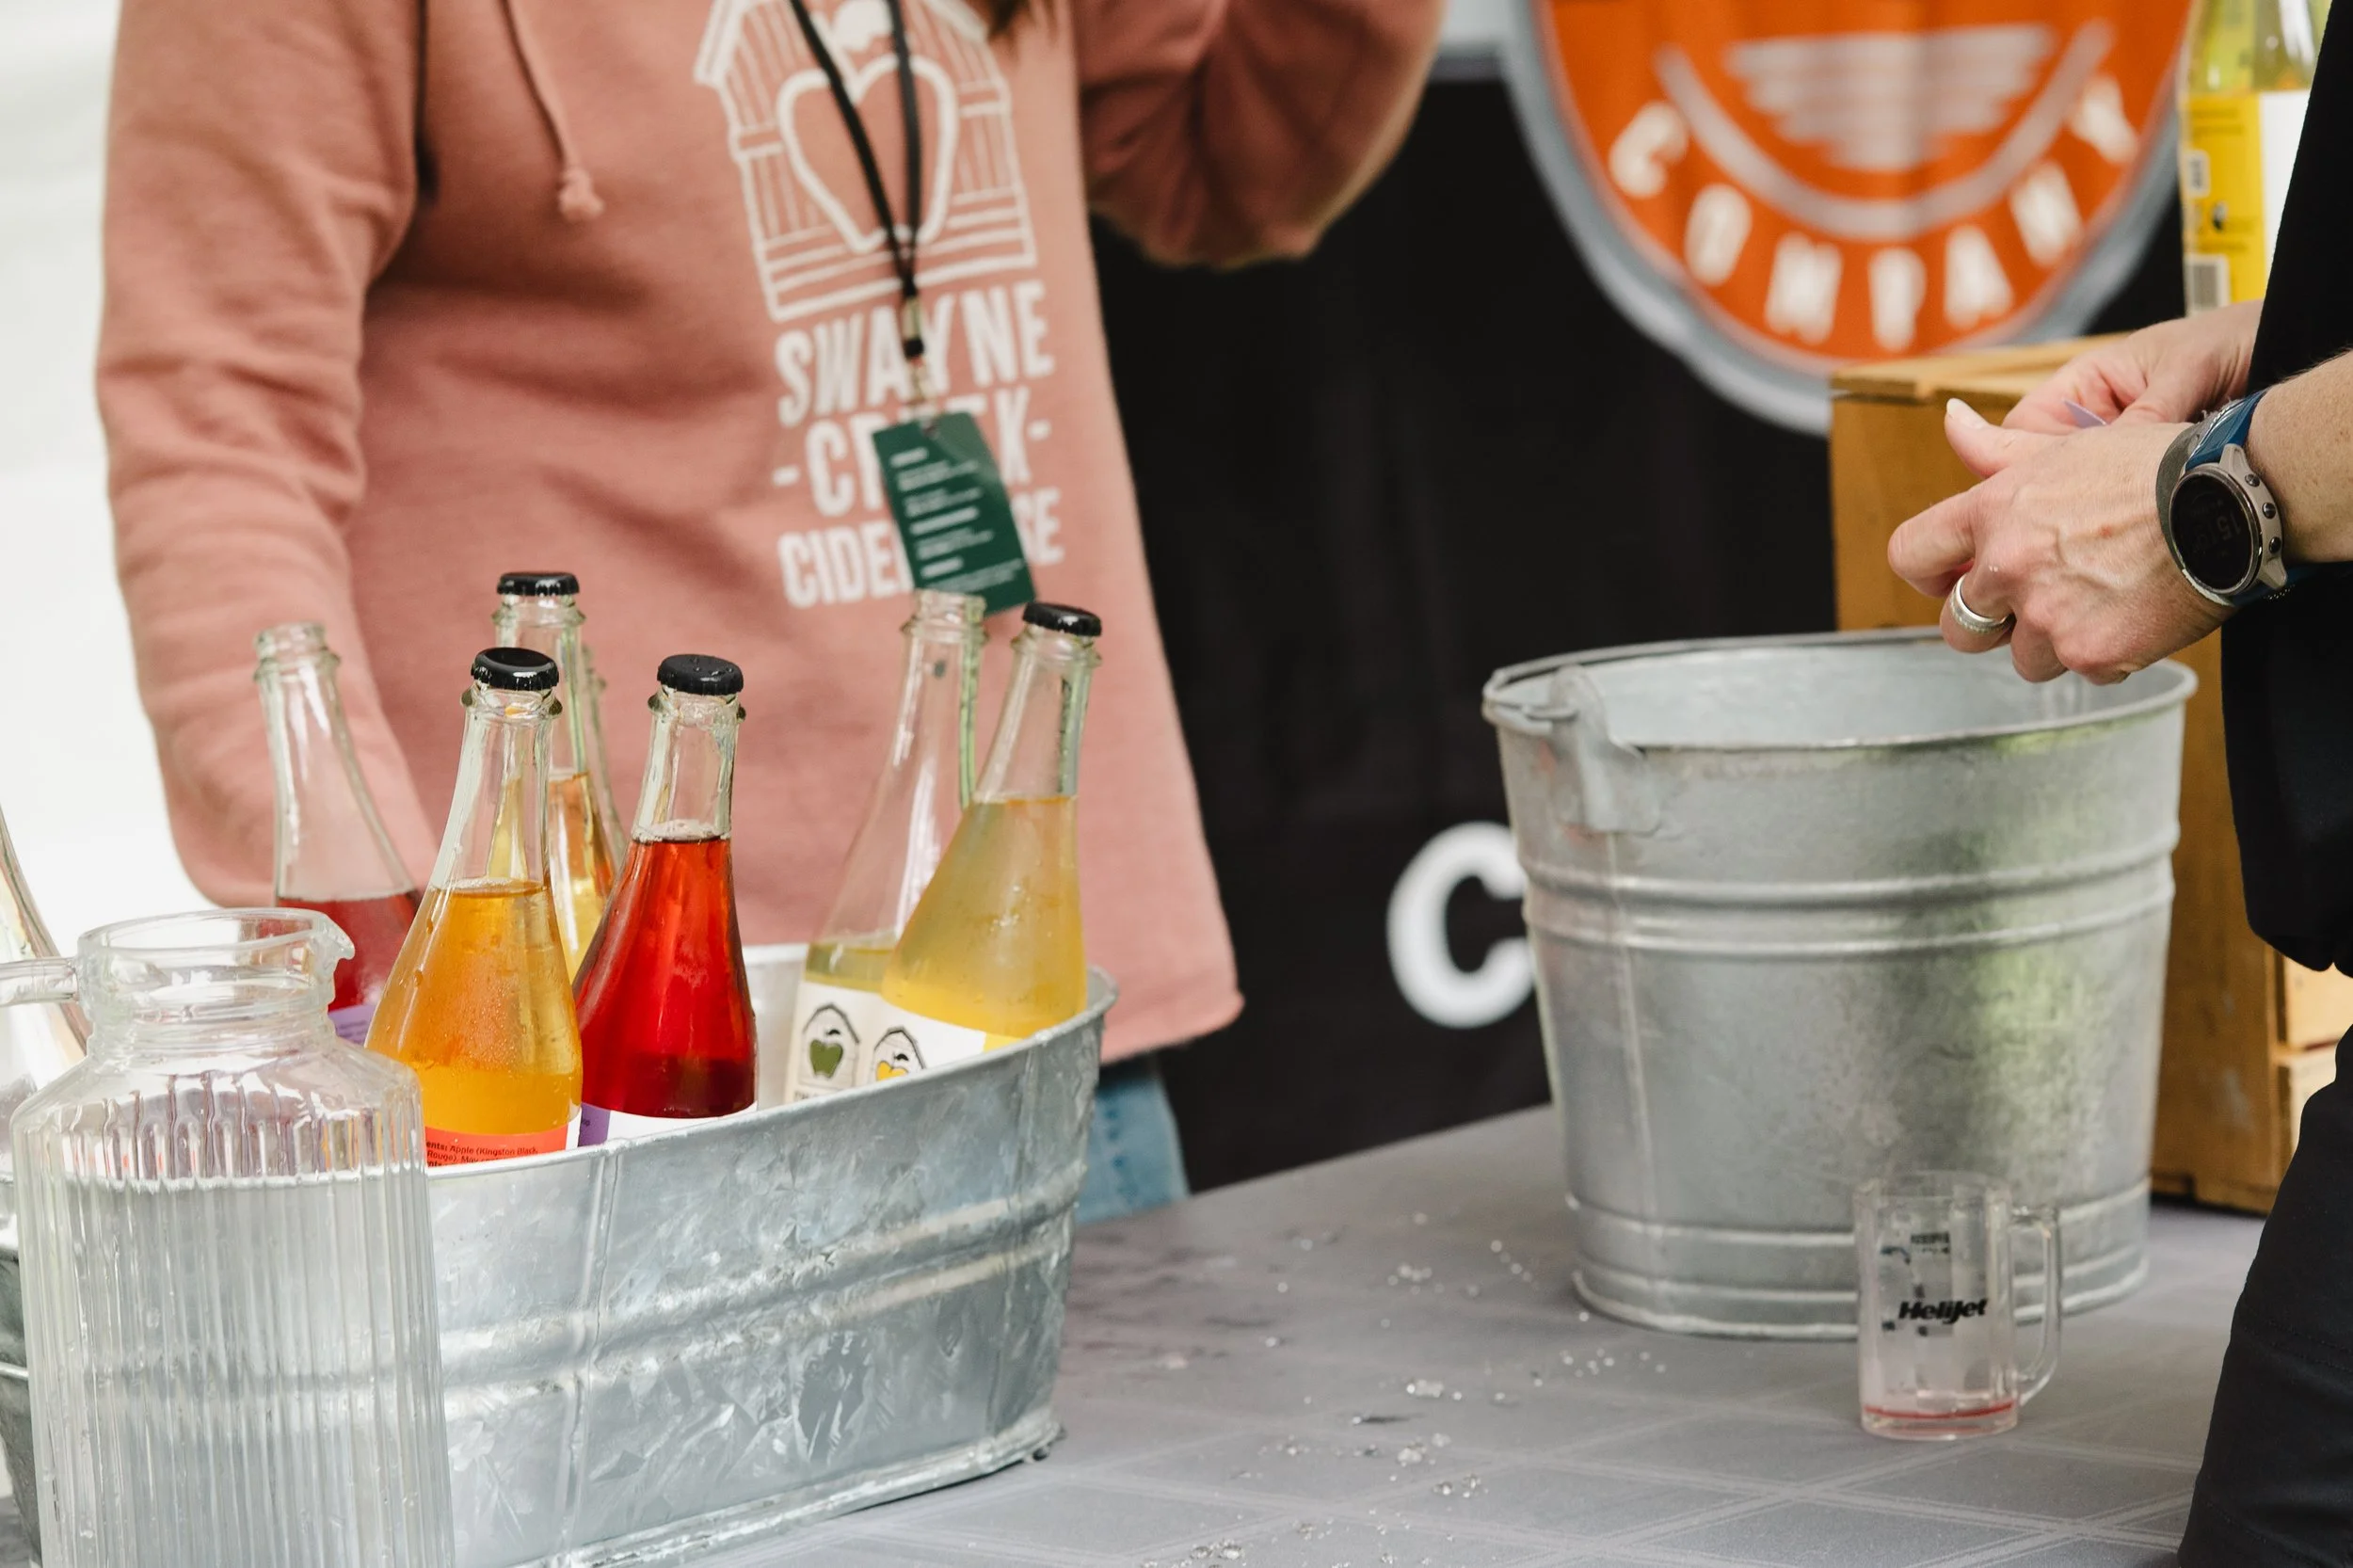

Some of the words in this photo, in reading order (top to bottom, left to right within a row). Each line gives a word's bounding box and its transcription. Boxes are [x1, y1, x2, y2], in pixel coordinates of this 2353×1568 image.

[1608, 73, 2138, 354] COMPANY
[775, 281, 1055, 427] SWAYNE
[450, 1145, 474, 1155] Apple
